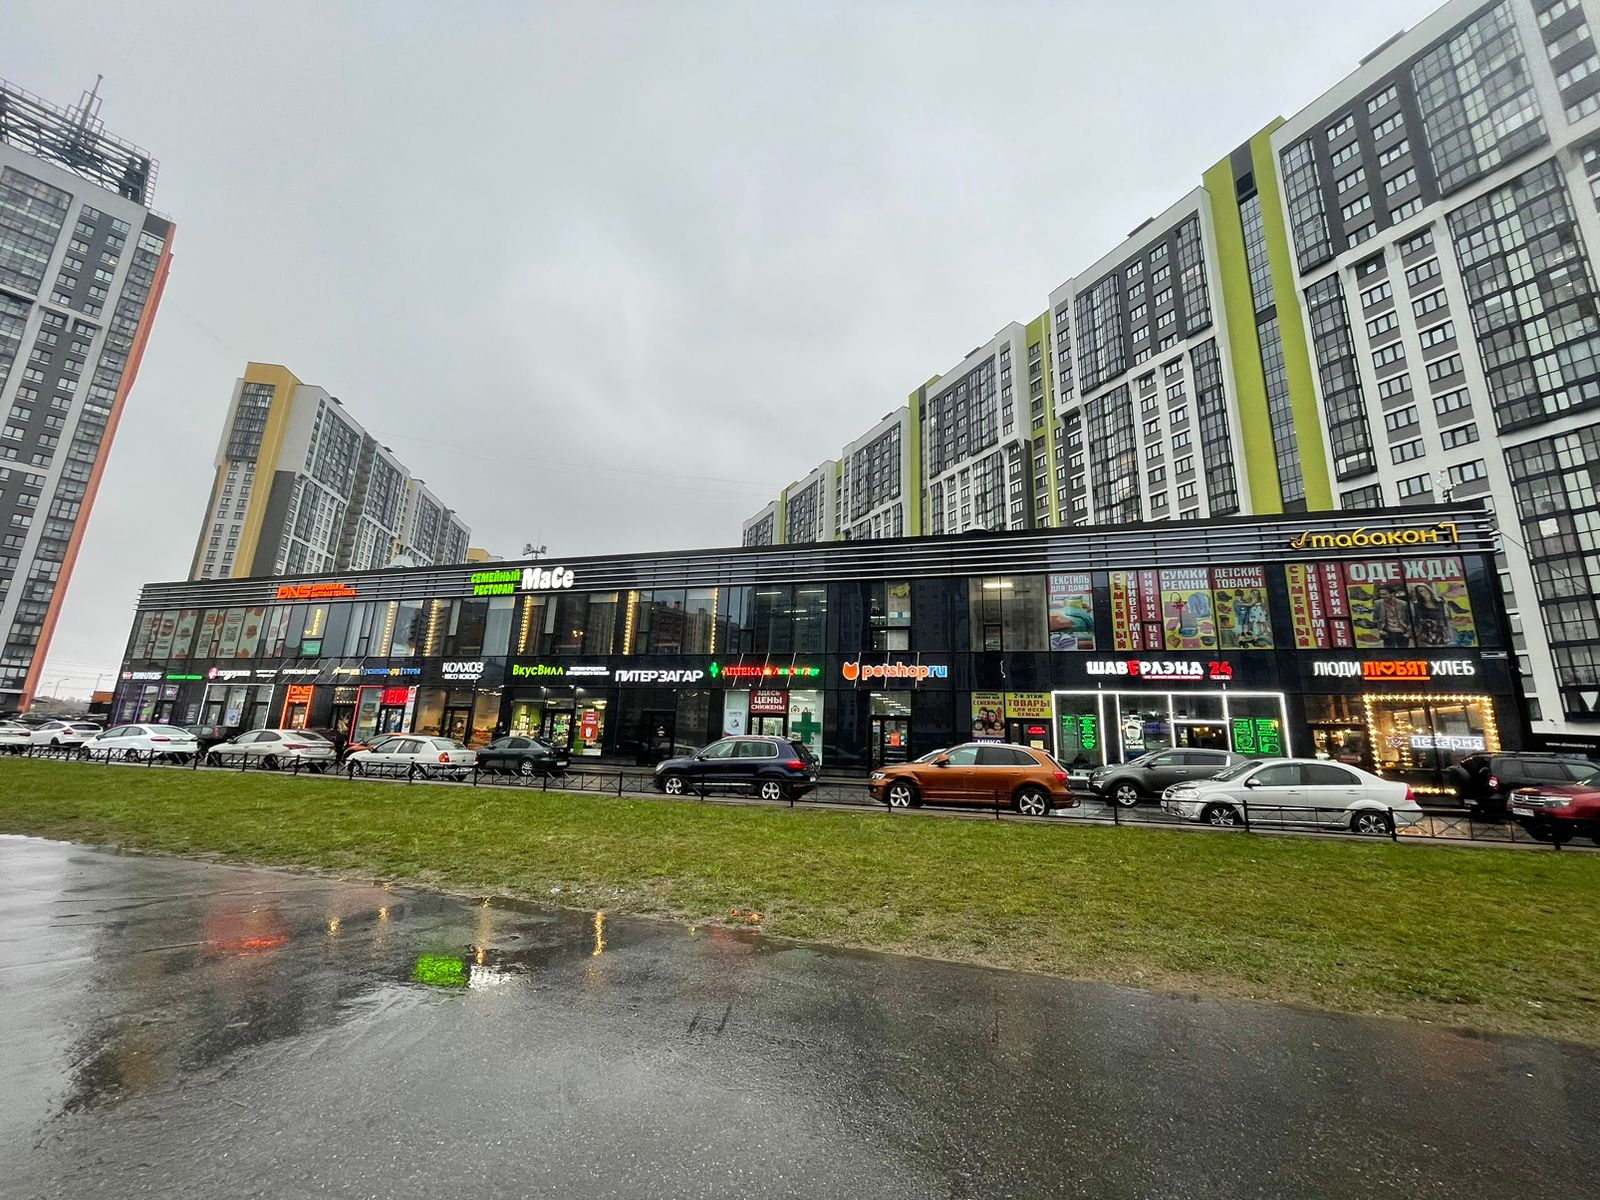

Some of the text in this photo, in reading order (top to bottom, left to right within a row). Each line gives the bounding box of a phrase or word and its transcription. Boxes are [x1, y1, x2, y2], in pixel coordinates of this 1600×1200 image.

[1311, 527, 1438, 548] табакон
[470, 569, 521, 583] СЕМЕЙНЫЙ
[1161, 569, 1207, 580] СУМКИ
[1214, 567, 1262, 579] ДЕТСКИЕ
[1050, 575, 1090, 585] ТЕКСТИЛЬ
[1162, 579, 1209, 590] РЕМНИ
[1216, 577, 1263, 588] ТОВАРЫ
[277, 586, 312, 599] DNS
[473, 583, 515, 596] РЕСТОРАН
[1148, 623, 1159, 649] ЦЕН
[1334, 621, 1348, 647] ЦЕН
[442, 662, 484, 673] КОЛХОЗ
[512, 664, 564, 678] ВкусВилл
[722, 667, 762, 677] АПТЕКА
[1086, 659, 1233, 676] ШАВЕРЛЭНД 24
[1313, 661, 1362, 678] ЛЮДИ
[1431, 660, 1475, 676] ХЛЕБ
[753, 696, 783, 705] ЦЕНЫ
[1006, 699, 1051, 708] ТОВАРЫ
[1411, 734, 1485, 751] пекарня
